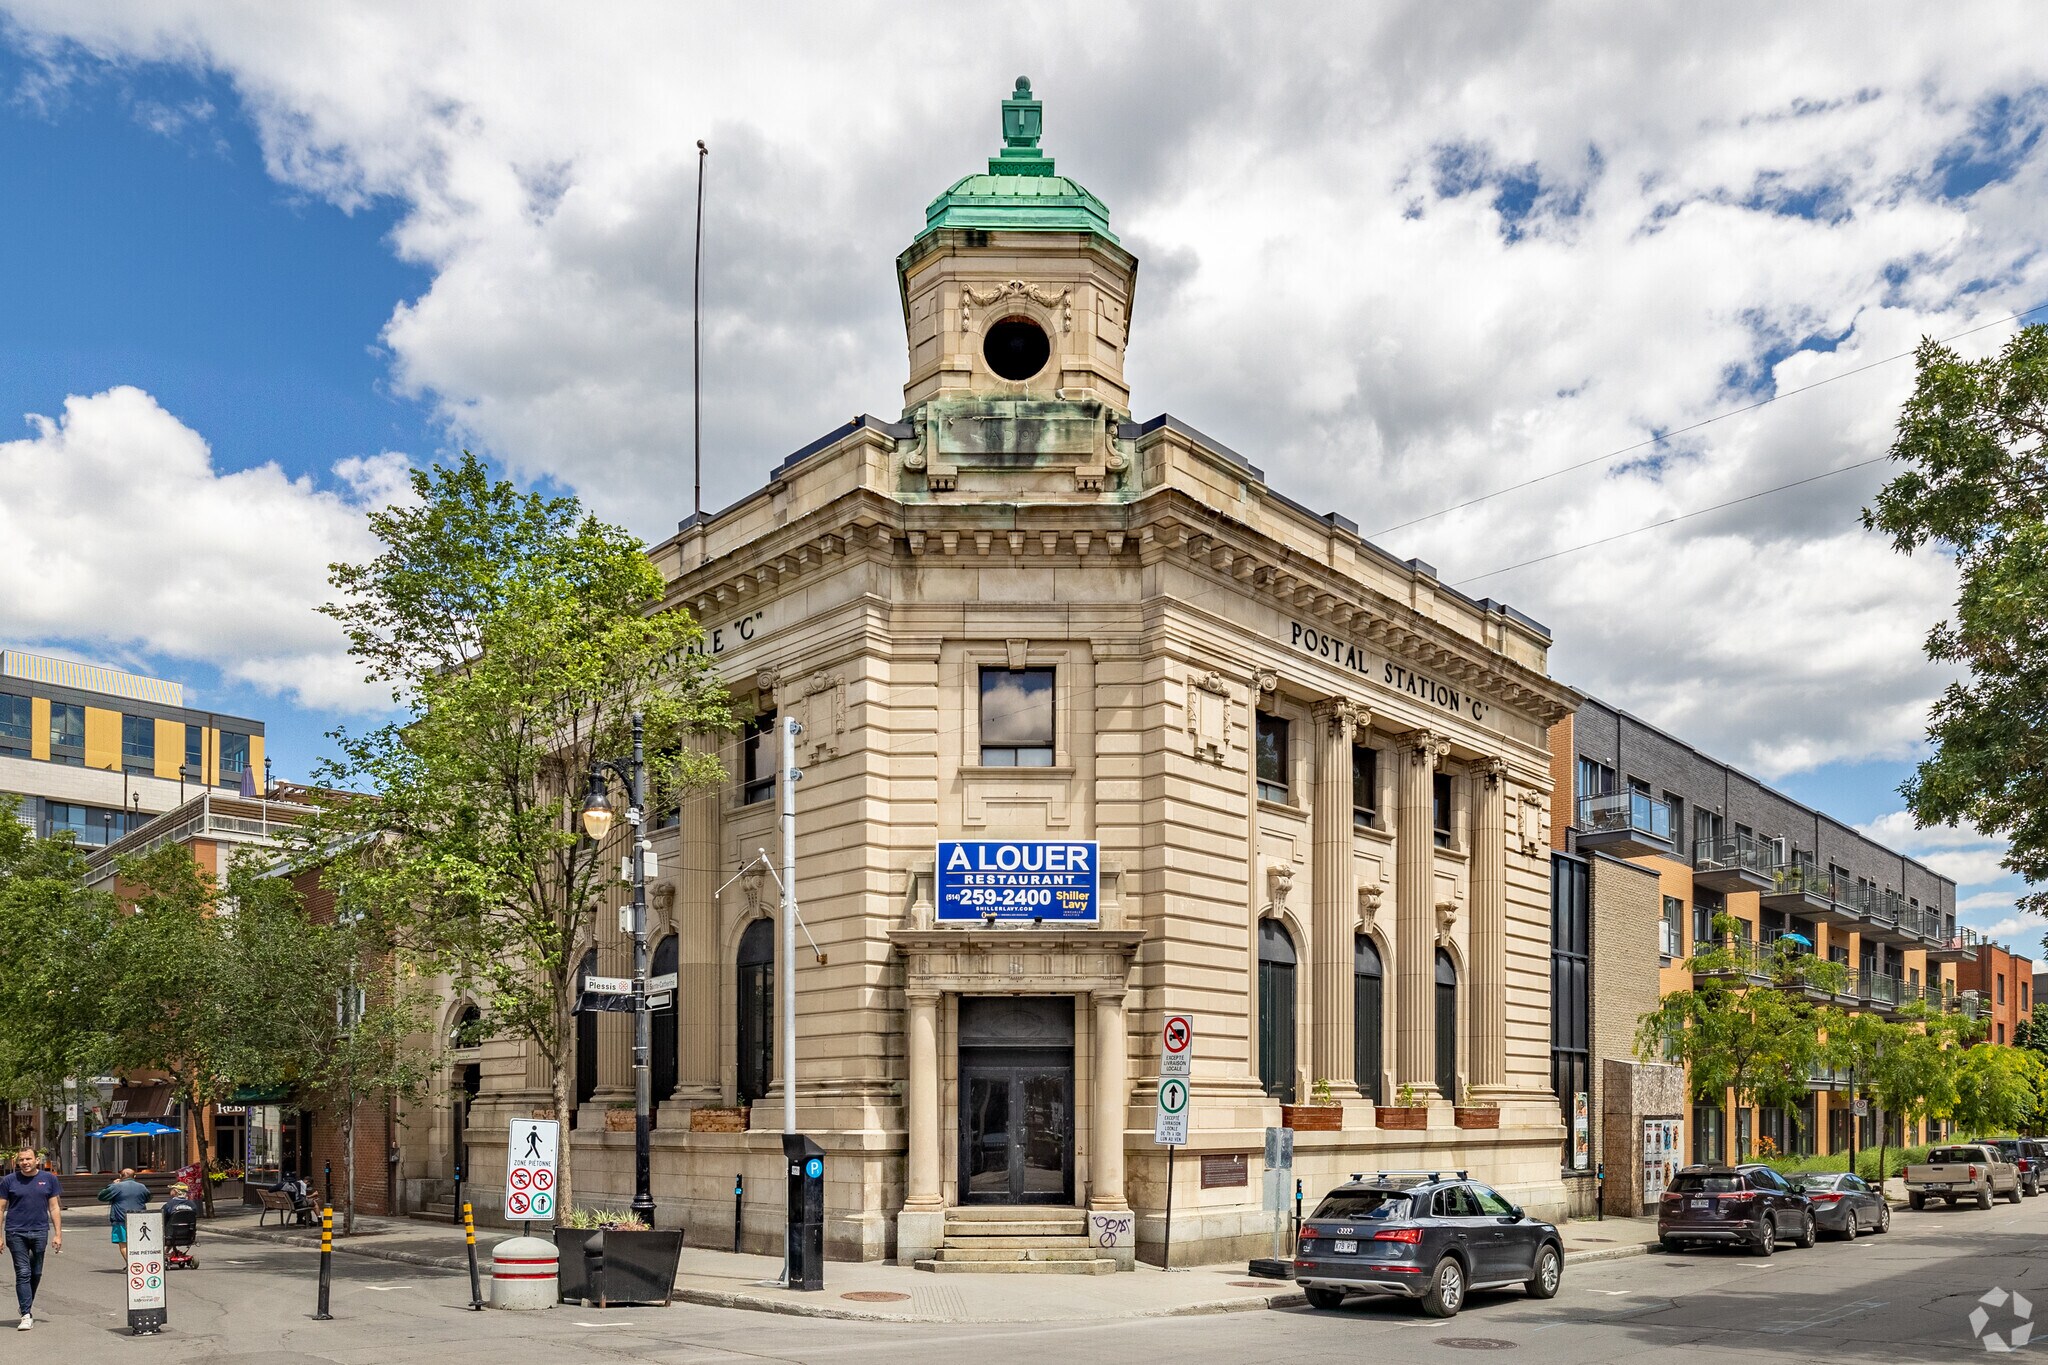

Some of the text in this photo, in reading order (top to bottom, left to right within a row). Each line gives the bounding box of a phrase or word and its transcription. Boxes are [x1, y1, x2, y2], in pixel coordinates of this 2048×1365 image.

[1291, 621, 1369, 675] POSTAL
[1384, 662, 1460, 713] STATION
[946, 843, 1089, 871] À LOUER
[964, 875, 1075, 885] RESTAURANT
[946, 889, 1052, 906] (514) 259-2400
[1056, 891, 1090, 901] Shiller
[1062, 900, 1088, 911] Lavy
[589, 981, 616, 991] Plessis
[528, 1159, 552, 1167] PIÉTONNE
